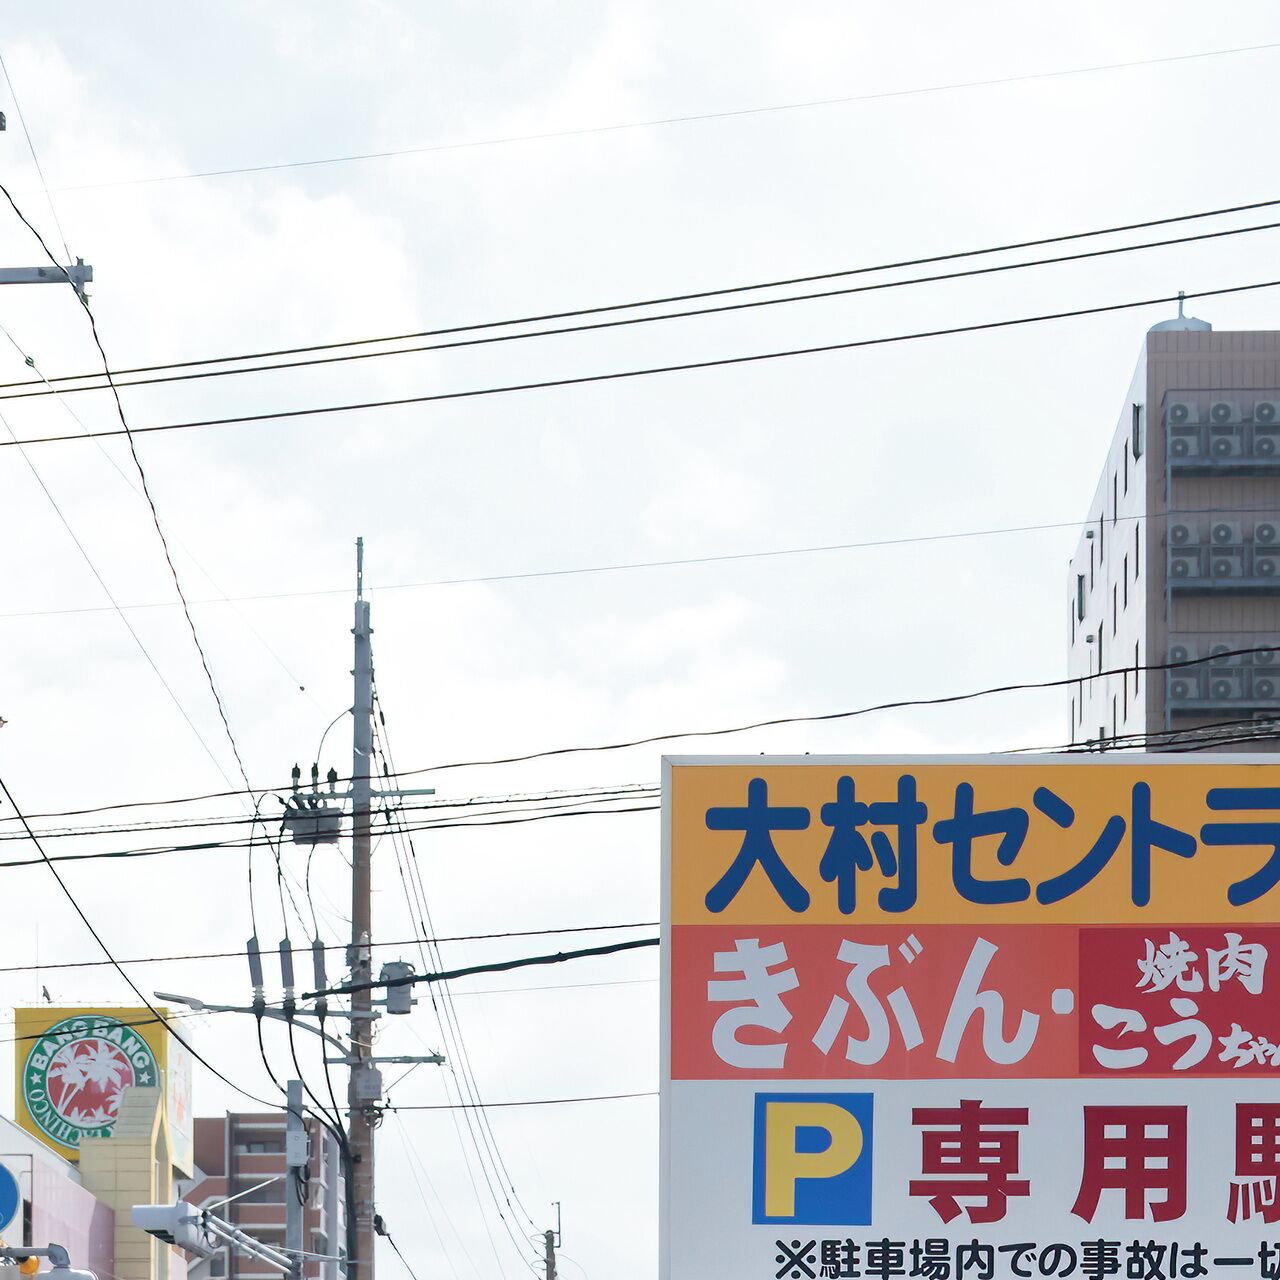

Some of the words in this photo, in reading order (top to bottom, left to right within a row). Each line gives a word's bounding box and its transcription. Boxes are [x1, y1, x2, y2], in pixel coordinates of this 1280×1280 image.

[1135, 931, 1270, 995] 焼肉
[30, 1020, 89, 1071] BANG
[92, 1019, 151, 1069] BANG
[764, 1125, 864, 1219] P
